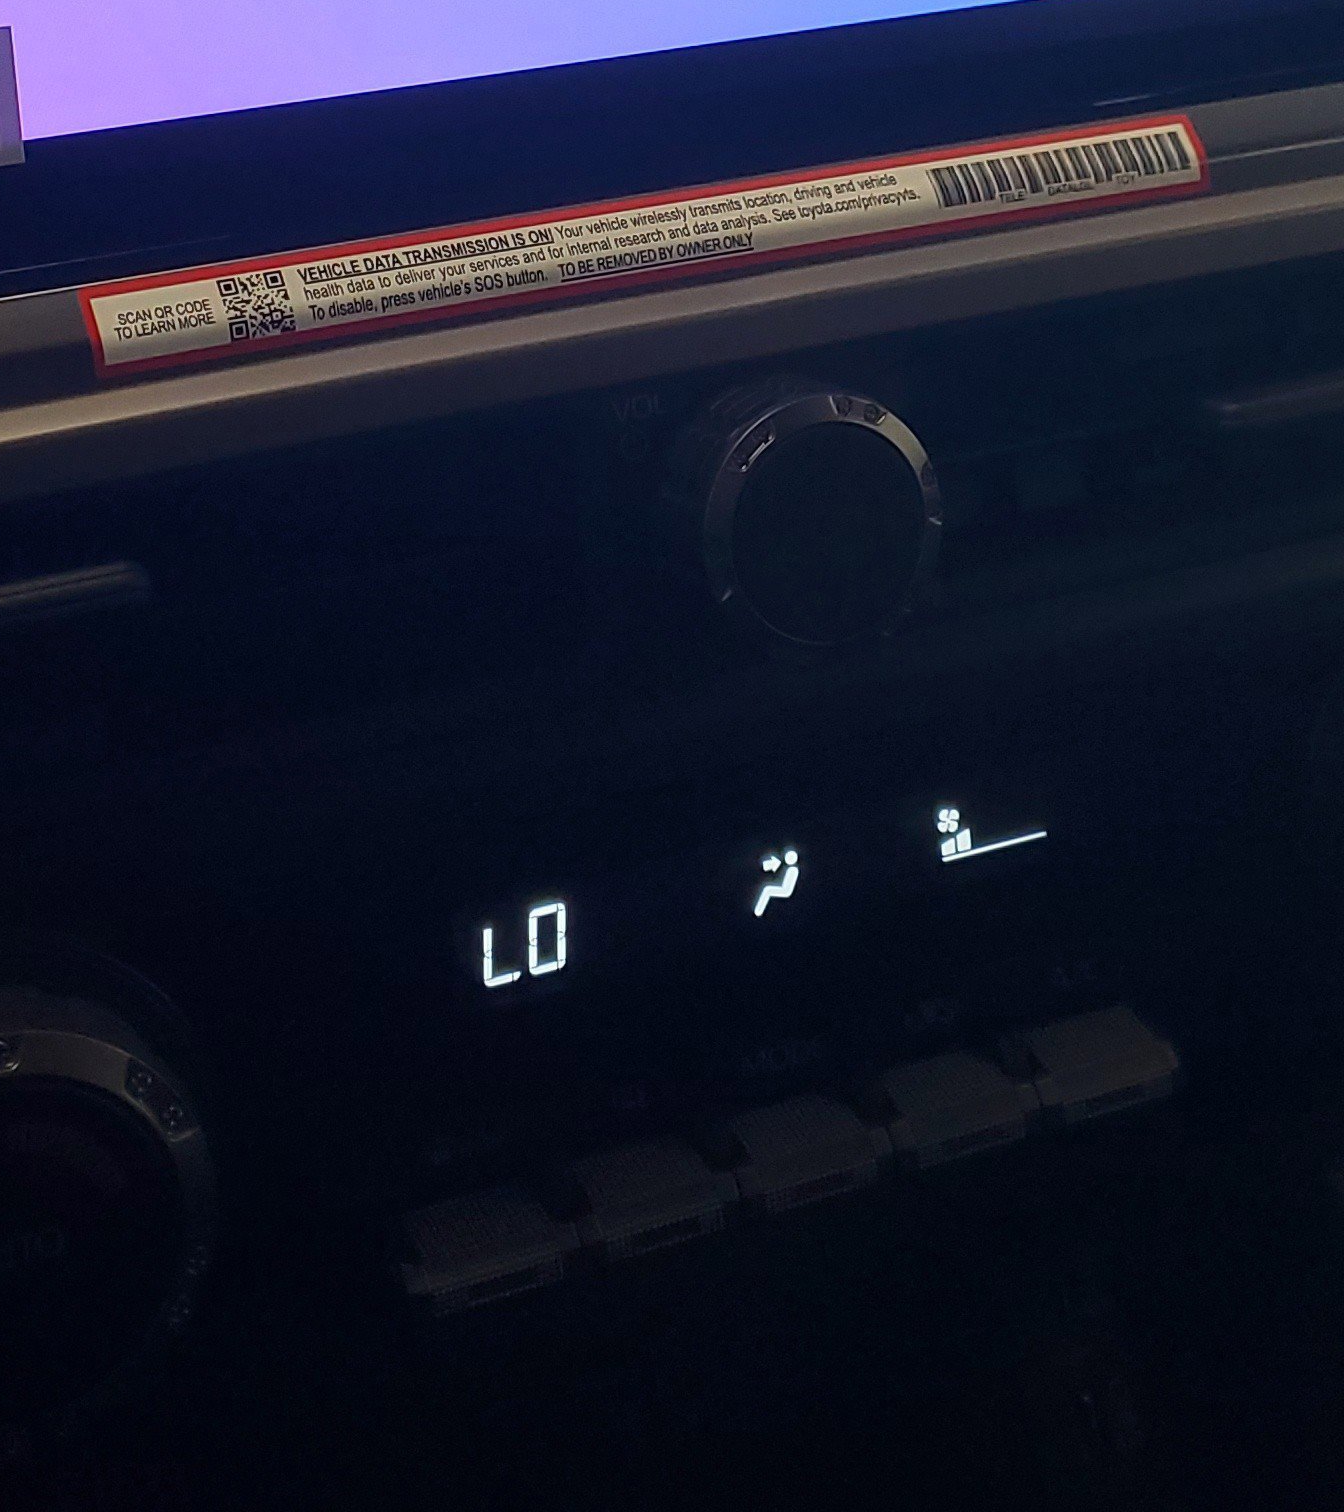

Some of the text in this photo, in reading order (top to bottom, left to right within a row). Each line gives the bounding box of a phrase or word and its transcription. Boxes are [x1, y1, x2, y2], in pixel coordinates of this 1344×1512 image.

[297, 173, 897, 284] VEHICLE DATA TRANSMISSION IS ON! Your vehicle wirelessly transmits location, driving and vehicle
[303, 278, 344, 301] health
[347, 273, 375, 294] data
[377, 271, 392, 288] to
[394, 263, 436, 286] deliver
[438, 261, 467, 282] your
[470, 252, 521, 274] services
[522, 247, 546, 265] and
[547, 244, 565, 260] for
[614, 226, 667, 248] research
[668, 221, 691, 240] and
[692, 218, 719, 236] data
[720, 210, 771, 232] analysis.
[772, 207, 796, 222] See
[117, 308, 153, 326] SCAN
[175, 299, 211, 316] CODE
[308, 231, 754, 322] To disable, press vehicle's SOS button. TO BE REMOVED BY OWNER ONLY
[113, 311, 216, 341] TO LEARN MORE
